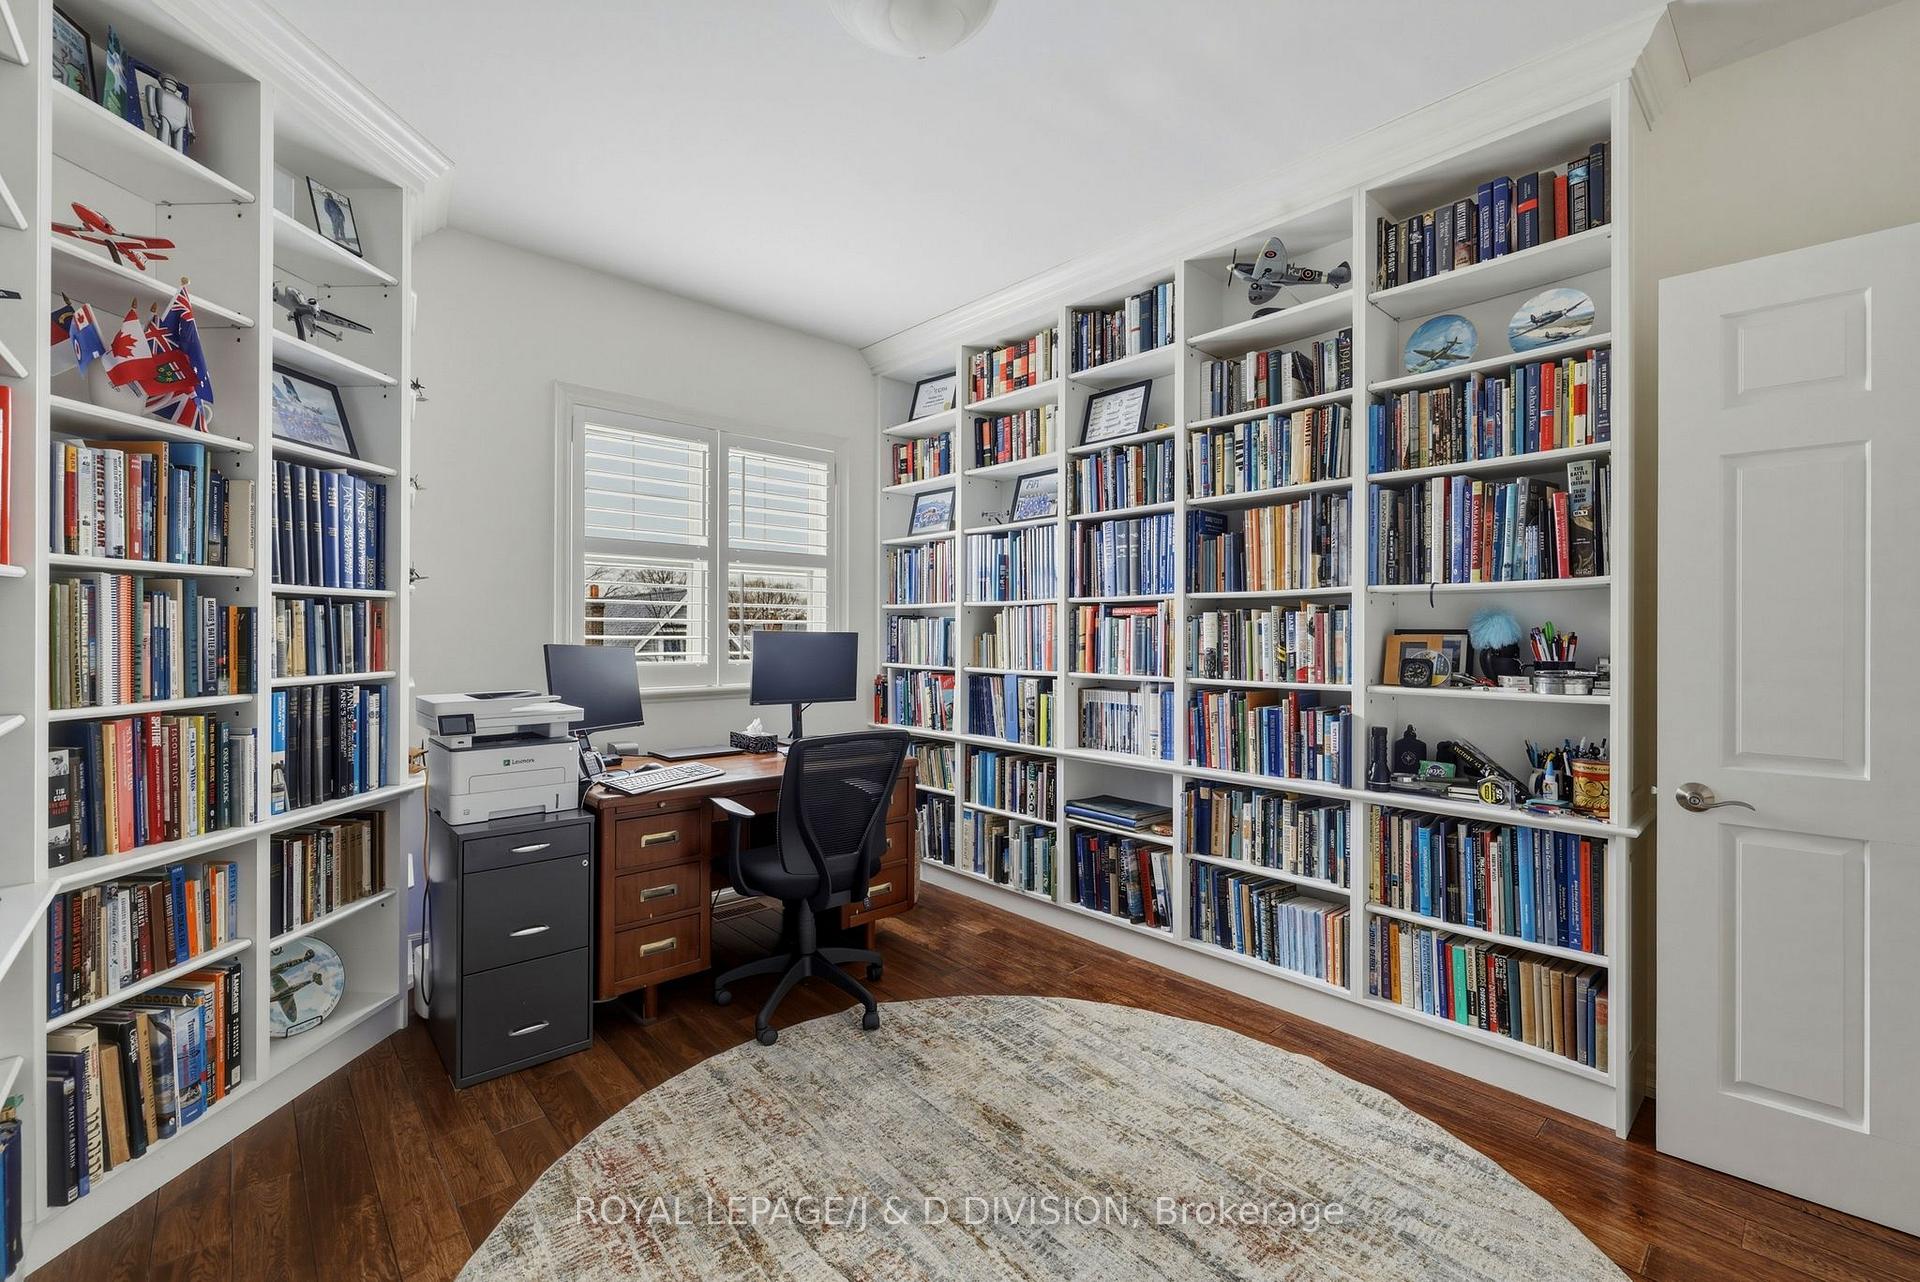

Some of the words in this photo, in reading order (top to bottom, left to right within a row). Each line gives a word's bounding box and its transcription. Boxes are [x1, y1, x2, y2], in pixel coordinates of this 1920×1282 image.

[1388, 227, 1396, 252] TAKING
[1388, 253, 1396, 273] PARIS
[1339, 346, 1351, 373] 1944
[1529, 385, 1537, 394] No
[97, 454, 106, 496] WINGS
[97, 499, 106, 516] OF
[342, 483, 352, 520] JANE'S
[356, 487, 366, 524] JANE'S
[97, 520, 106, 548] WAR
[208, 628, 216, 648] BATTLE
[1223, 642, 1229, 652] OF
[151, 716, 161, 747] SPITFIRE
[137, 890, 145, 927] DEMOCRACY
[232, 972, 240, 1015] LANCASTER
[1479, 987, 1487, 1018] DIRECTORY
[1488, 984, 1497, 1023] DIRECTORY
